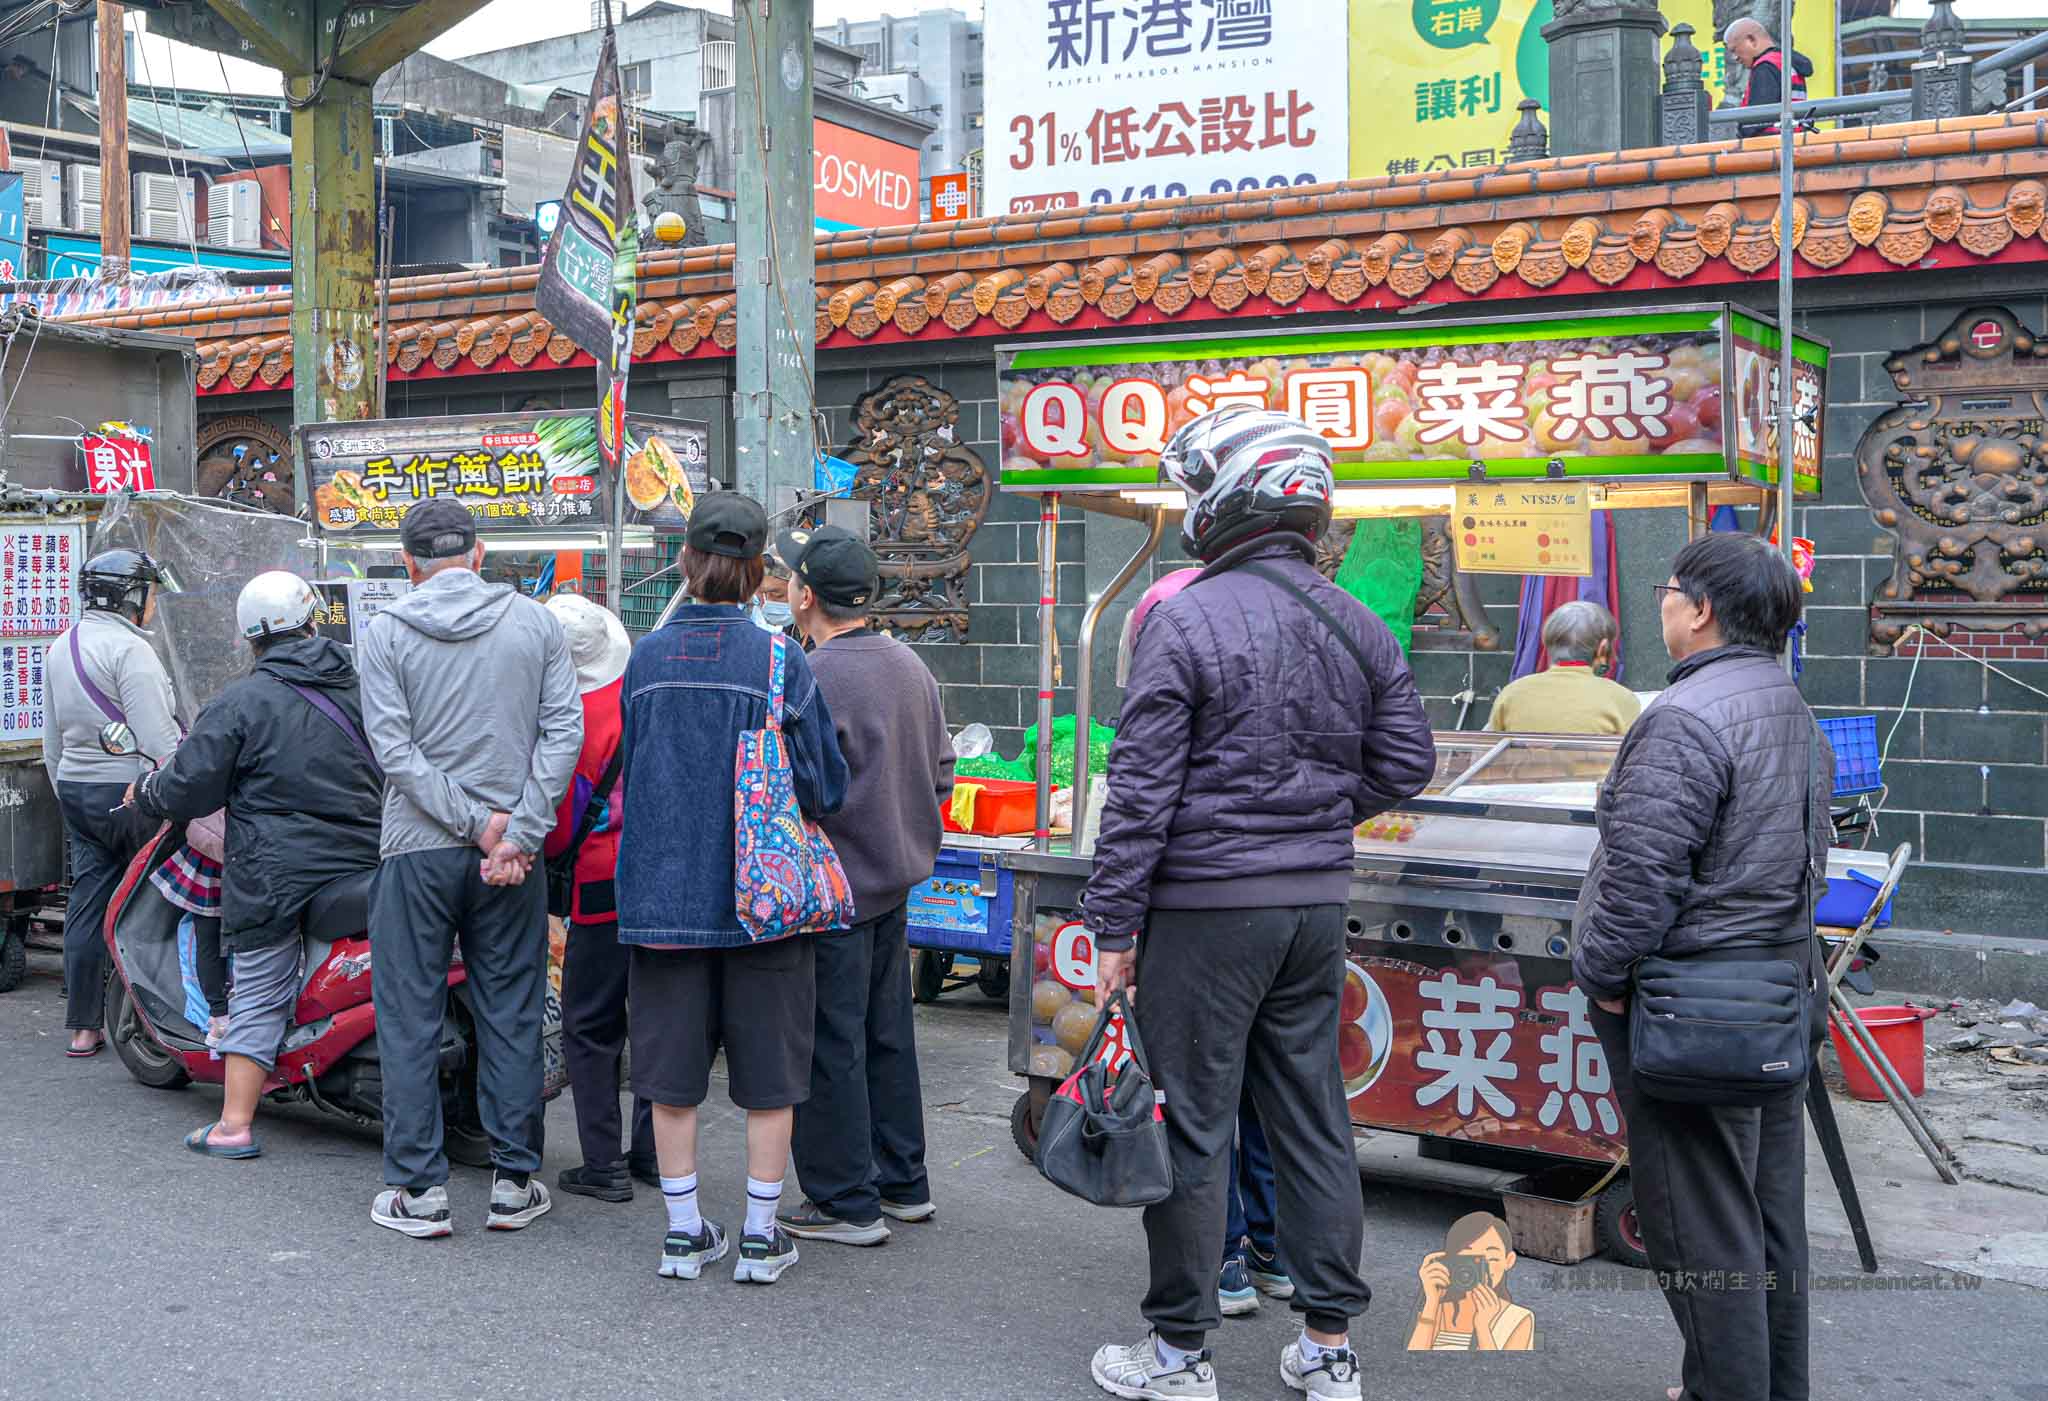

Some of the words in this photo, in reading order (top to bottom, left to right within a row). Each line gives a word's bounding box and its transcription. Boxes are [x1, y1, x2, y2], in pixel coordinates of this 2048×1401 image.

[1048, 0, 1273, 71] 新港灣
[1431, 7, 1482, 36] 右岸
[1048, 76, 1102, 88] TAIPEI
[1114, 66, 1181, 81] HARBOR
[1193, 57, 1274, 72] MANSION
[1415, 72, 1501, 122] 讓利
[94, 447, 147, 493] 果汁
[3, 535, 15, 616] 火龍果牛奶
[17, 535, 29, 616] 芒果牛奶
[31, 535, 43, 616] 草莓牛奶
[45, 535, 57, 616] 蘋果牛奶
[59, 535, 70, 616] 酪梨牛奶
[17, 646, 29, 706] 百香果
[31, 646, 43, 706] 石蓮花
[3, 713, 15, 730] 60
[17, 713, 29, 729] 60
[31, 711, 43, 728] 65
[1414, 968, 1622, 1138] 菜燕
